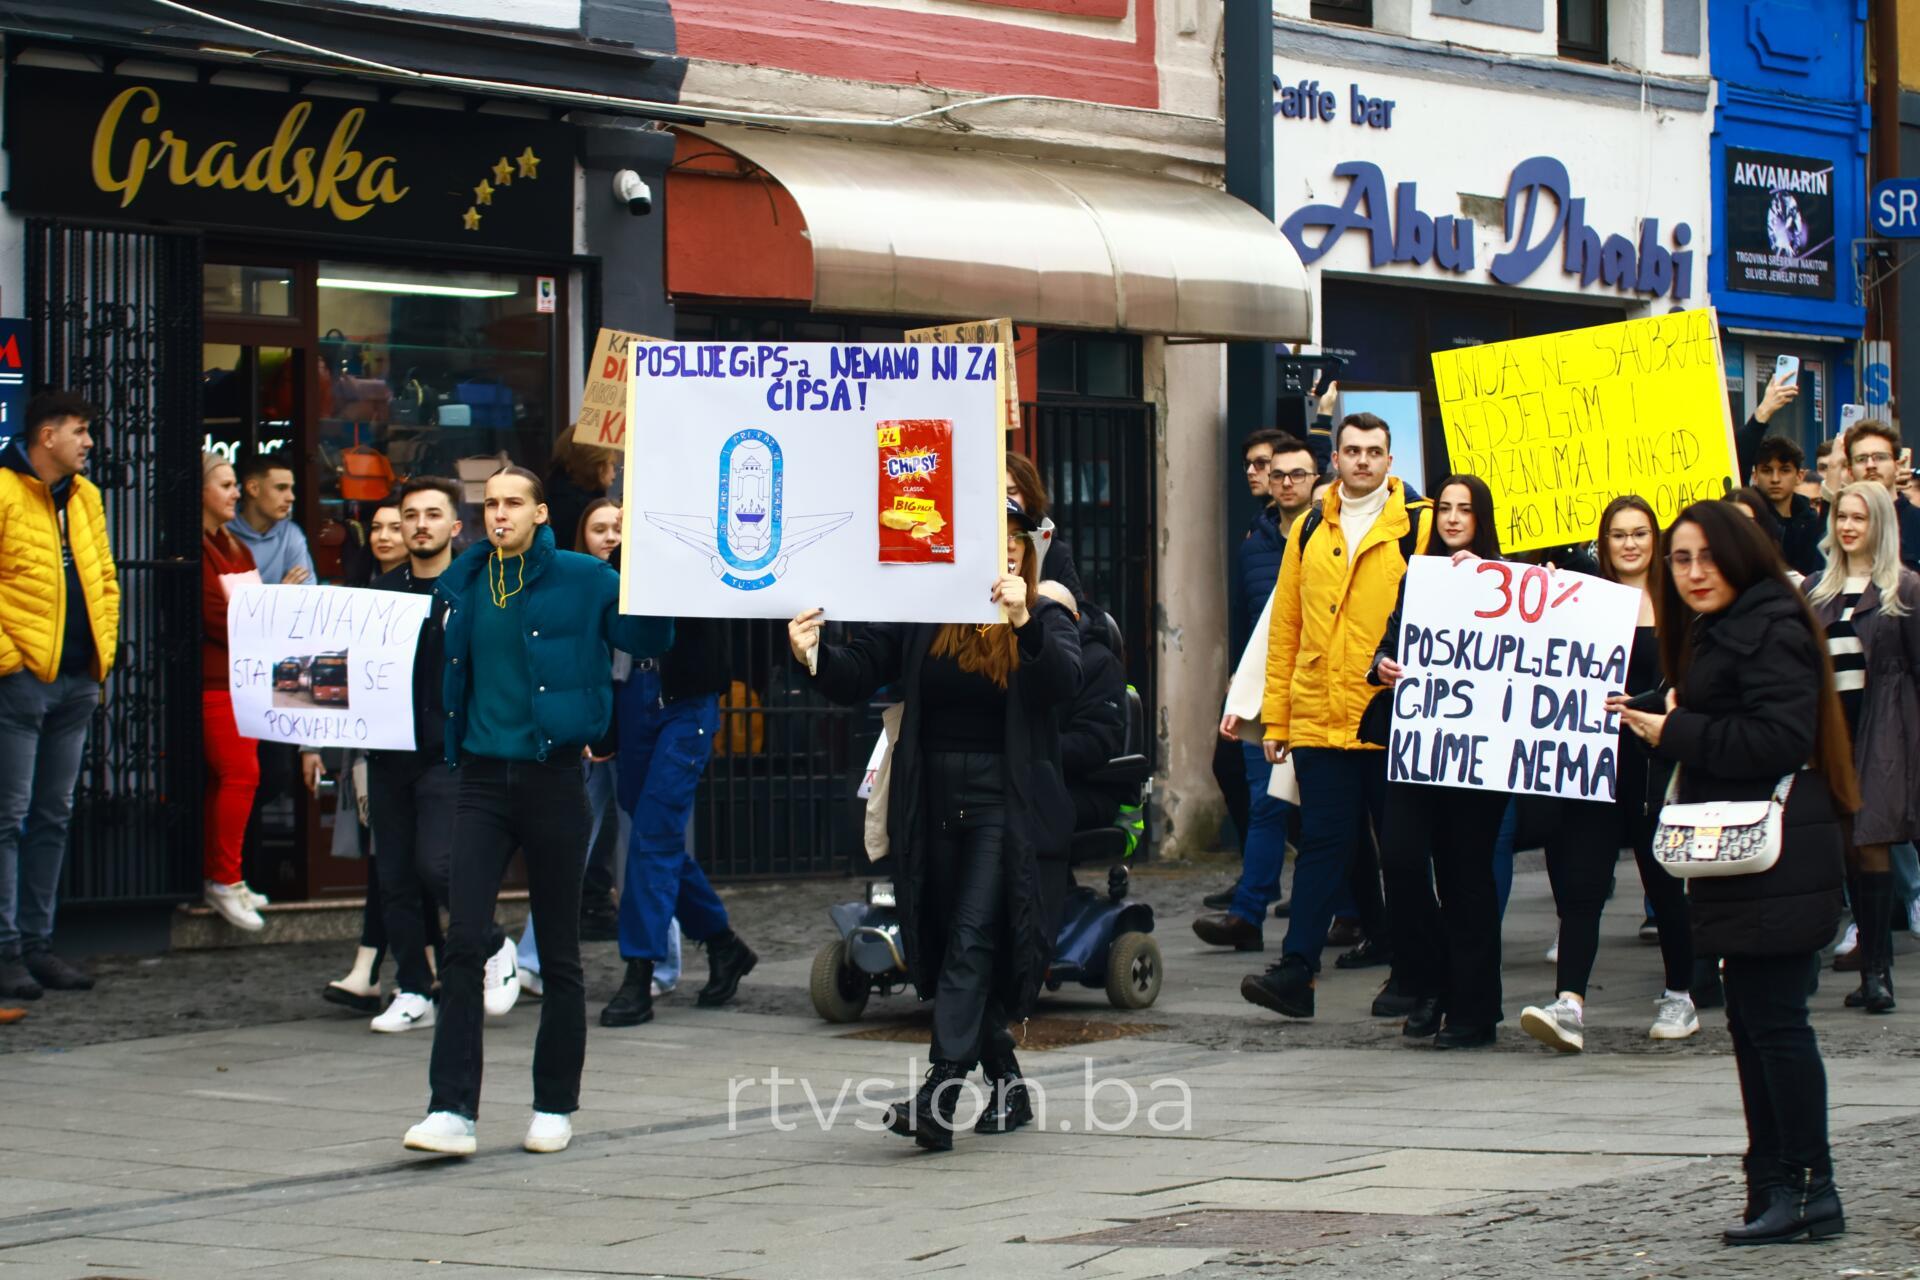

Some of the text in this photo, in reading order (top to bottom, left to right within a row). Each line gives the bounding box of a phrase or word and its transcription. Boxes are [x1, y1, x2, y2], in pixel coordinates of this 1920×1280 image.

[1350, 83, 1396, 129] bar
[91, 86, 410, 221] Gradska
[1734, 162, 1828, 195] AKVAMARIN
[1279, 155, 1694, 300] Abu Dhabi
[1735, 251, 1767, 265] TRGOVINA
[1800, 258, 1828, 272] NAKITOM
[1744, 267, 1820, 287] SILVER JEWELRY STORE
[830, 346, 919, 380] NEMAMO
[932, 346, 957, 380] NI
[964, 346, 997, 380] ZA
[1540, 332, 1581, 388] NE
[1629, 382, 1638, 425] I
[881, 430, 896, 443] XL
[1605, 438, 1610, 481] I
[1626, 428, 1701, 478] NIKAD
[895, 500, 916, 511] BIG
[234, 587, 279, 639] MI
[1473, 561, 1584, 624] 30%
[364, 660, 396, 690] SE
[264, 709, 369, 741] POKVARILO
[1507, 738, 1617, 800] NEMA
